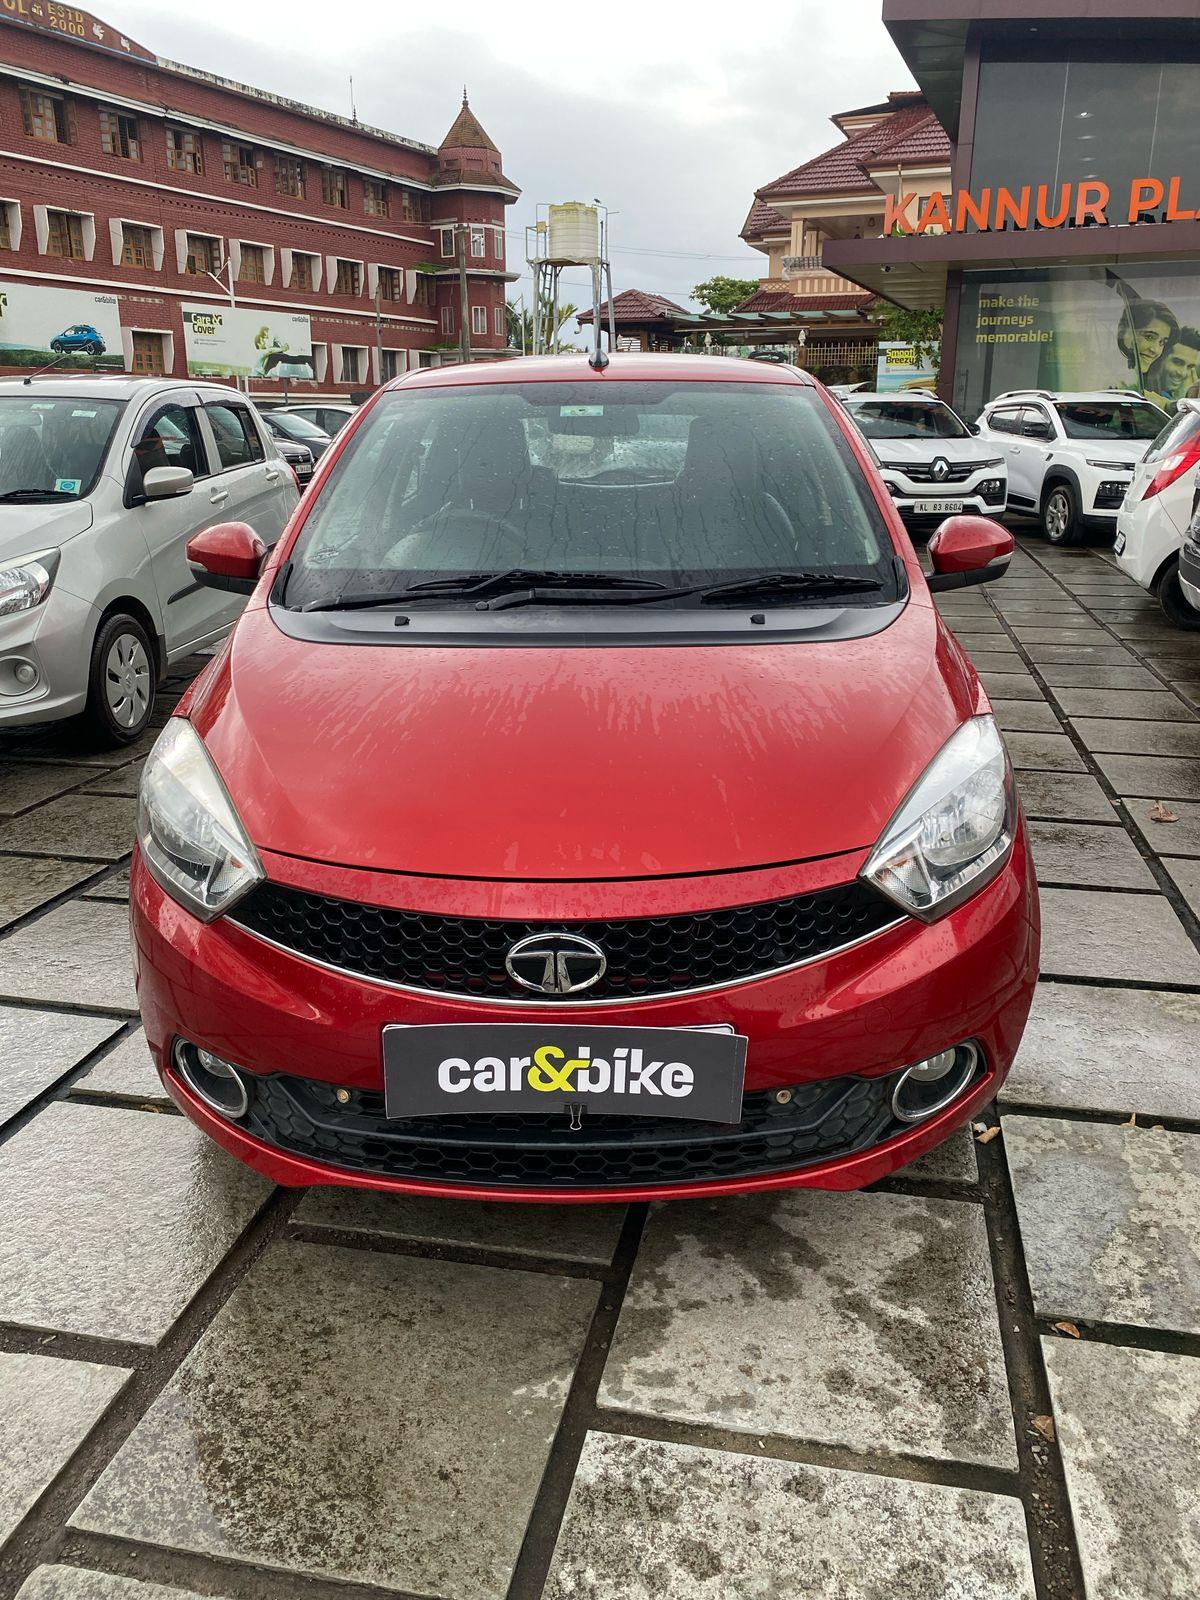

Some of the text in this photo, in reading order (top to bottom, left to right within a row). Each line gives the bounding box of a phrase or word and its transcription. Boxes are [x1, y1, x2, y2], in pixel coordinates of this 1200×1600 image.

[47, 2, 84, 23] ESTD
[49, 16, 86, 37] 2000
[883, 176, 1200, 235] KANNUR PL
[979, 295, 1040, 308] make the
[191, 313, 211, 325] Care
[976, 313, 1034, 328] journeys
[192, 323, 216, 335] Cover
[976, 330, 1053, 343] memorable!
[886, 356, 915, 366] Breezy
[437, 1046, 695, 1098] car&bike
